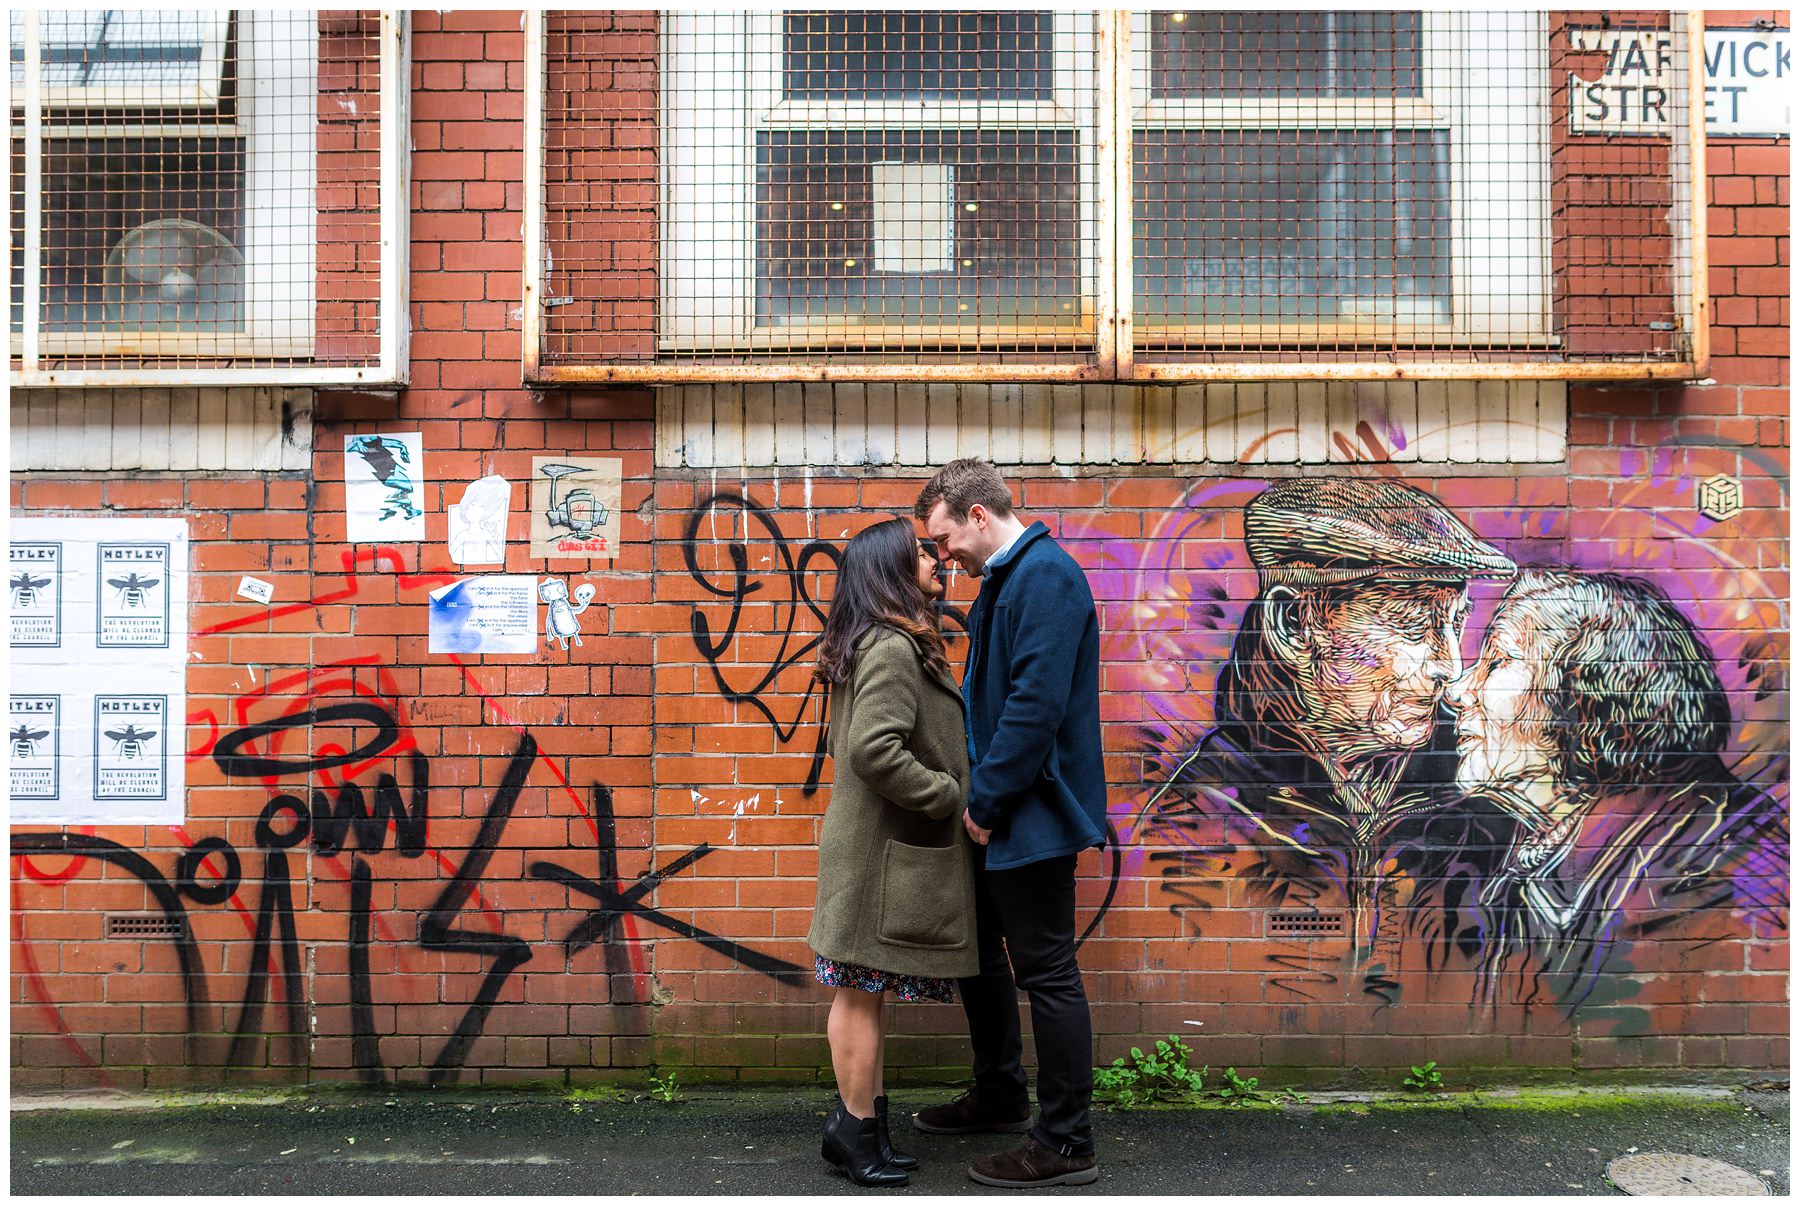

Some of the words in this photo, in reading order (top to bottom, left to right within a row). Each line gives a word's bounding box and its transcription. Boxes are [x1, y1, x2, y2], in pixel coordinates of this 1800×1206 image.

[1585, 83, 1748, 123] STRET
[104, 550, 163, 559] MOTLEY
[10, 702, 53, 710] TLEY
[102, 702, 160, 710] MOTLEY
